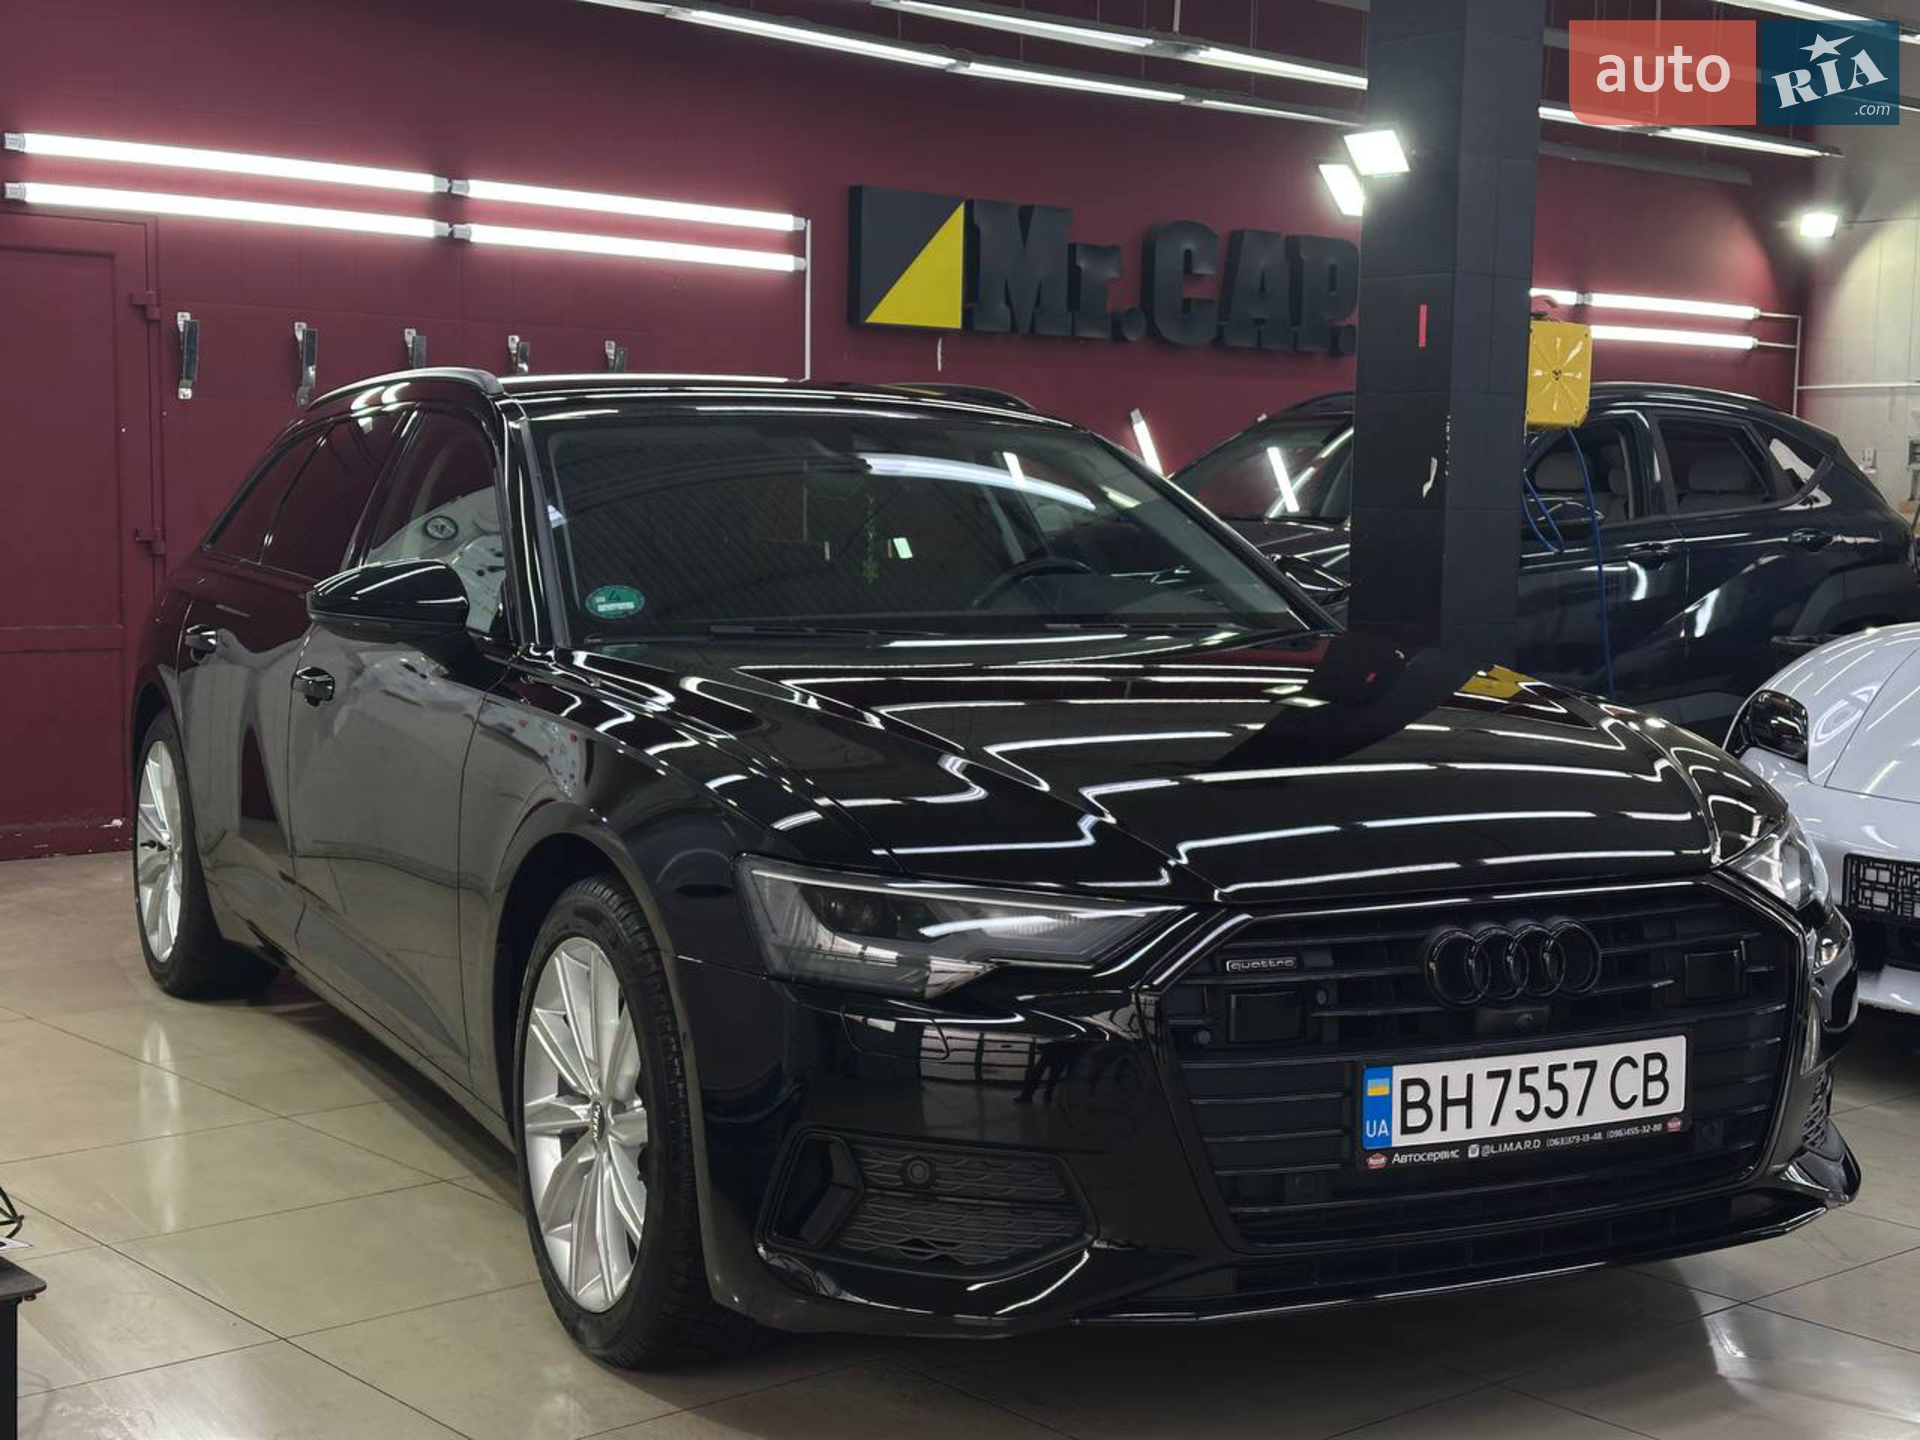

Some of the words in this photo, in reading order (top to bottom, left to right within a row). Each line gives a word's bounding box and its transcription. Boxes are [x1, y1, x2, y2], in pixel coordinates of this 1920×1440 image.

[1229, 959, 1294, 972] quattro
[1400, 1073, 1474, 1136] BH
[1486, 1059, 1598, 1127] 7557
[1610, 1051, 1670, 1111] CB
[1366, 1118, 1389, 1138] UA
[1392, 1149, 1460, 1164] Автосервис
